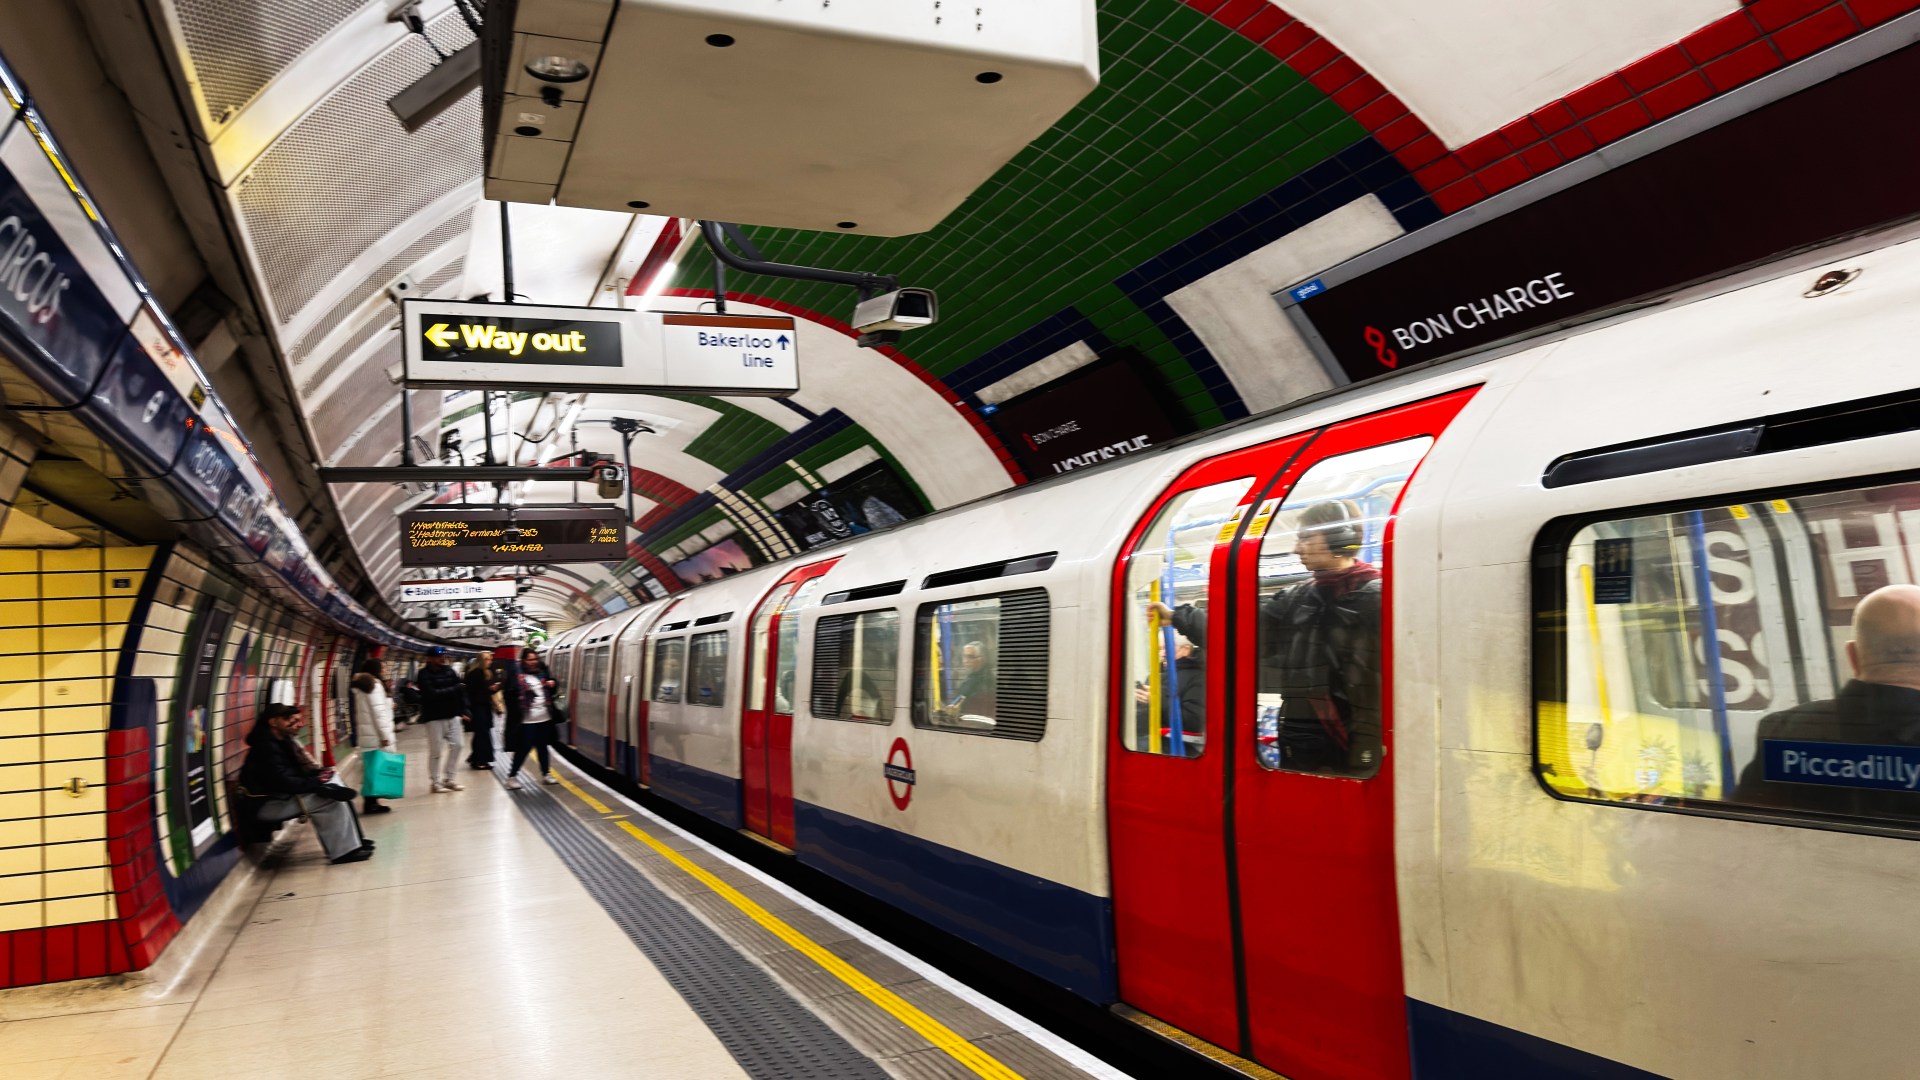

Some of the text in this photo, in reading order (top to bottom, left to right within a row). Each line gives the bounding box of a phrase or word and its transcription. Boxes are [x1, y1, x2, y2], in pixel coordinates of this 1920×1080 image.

[0, 215, 70, 323] CIRCUS
[1392, 272, 1575, 351] BON CHARGE
[460, 324, 586, 356] Way out
[697, 331, 773, 348] Bakerloo
[742, 353, 774, 368] line
[1032, 430, 1051, 445] BON
[416, 530, 461, 539] Heathrow
[415, 586, 483, 596] Bakerloo line
[1782, 749, 1920, 789] Piccadilly
